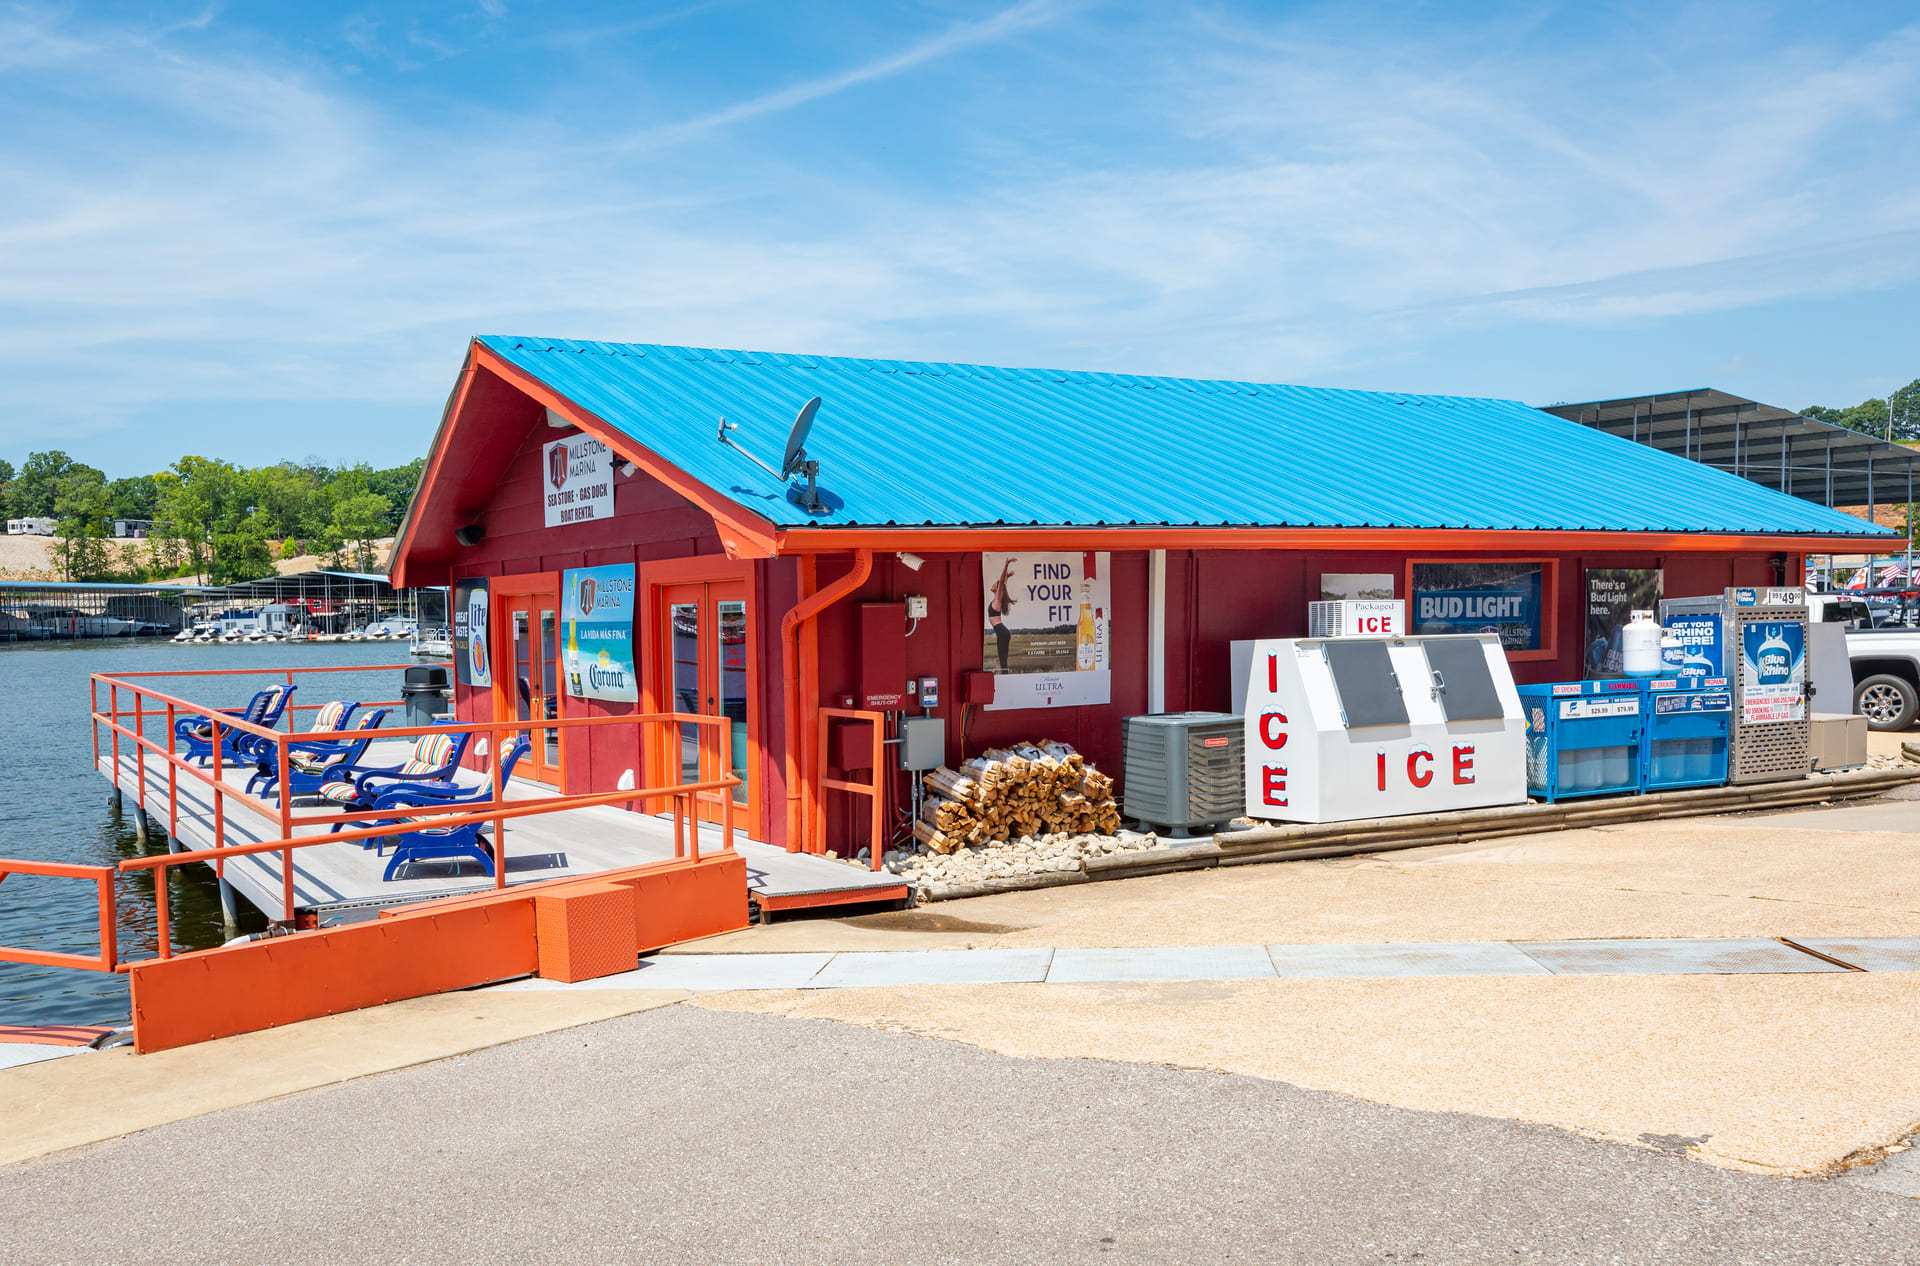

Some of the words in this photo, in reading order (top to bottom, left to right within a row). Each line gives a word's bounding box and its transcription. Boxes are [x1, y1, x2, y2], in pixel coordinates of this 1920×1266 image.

[569, 440, 607, 460] MILLSTONE
[569, 459, 597, 478] MARINA
[548, 494, 558, 507] SEA
[558, 490, 574, 505] STORE
[580, 485, 591, 501] GAS
[592, 483, 608, 499] DOCK
[561, 508, 574, 523] BOAT
[575, 505, 595, 521] RENTAL
[1033, 563, 1071, 580] FIND
[597, 578, 632, 593] MILLSTONE
[1590, 579, 1619, 590] There's
[1620, 582, 1626, 590] a
[1027, 584, 1072, 601] YOUR
[1590, 592, 1606, 602] Bud
[1607, 592, 1627, 604] Light
[597, 595, 620, 608] MARINA
[1355, 602, 1394, 611] Packaged
[1420, 597, 1464, 618] BUD
[1465, 597, 1522, 618] LIGHT
[1590, 604, 1611, 615] here.
[455, 611, 468, 623] GREAT
[471, 603, 486, 633] Lite
[1048, 605, 1072, 622] FIT
[1358, 616, 1391, 633] ICE
[455, 626, 468, 637] TASTE
[580, 630, 587, 640] LA
[587, 630, 599, 640] VIDA
[612, 629, 626, 640] FINA
[1500, 627, 1532, 637] MILLSTONE
[1673, 627, 1714, 637] RHINO
[1095, 624, 1103, 663] ULTRA
[1501, 636, 1523, 645] MARINA
[1765, 654, 1785, 664] Blue
[1603, 659, 1623, 672] LIGH
[1682, 667, 1706, 675] Blue
[1763, 665, 1789, 676] Rhino
[589, 663, 624, 693] Corona
[1704, 678, 1725, 686] PROPANE
[1035, 682, 1063, 691] ULTRA
[1553, 686, 1560, 694] NO
[1561, 685, 1581, 693] SMOKING
[1608, 681, 1637, 690] FLAMMABLE
[1658, 680, 1676, 688] SMOKING
[1745, 697, 1770, 706] EMERGENCIES
[1745, 707, 1751, 715] NO
[1751, 706, 1770, 714] SMOKING
[1751, 712, 1775, 721] FLAMMABLE
[1259, 648, 1288, 807] ICE
[1377, 741, 1475, 791] ICE
